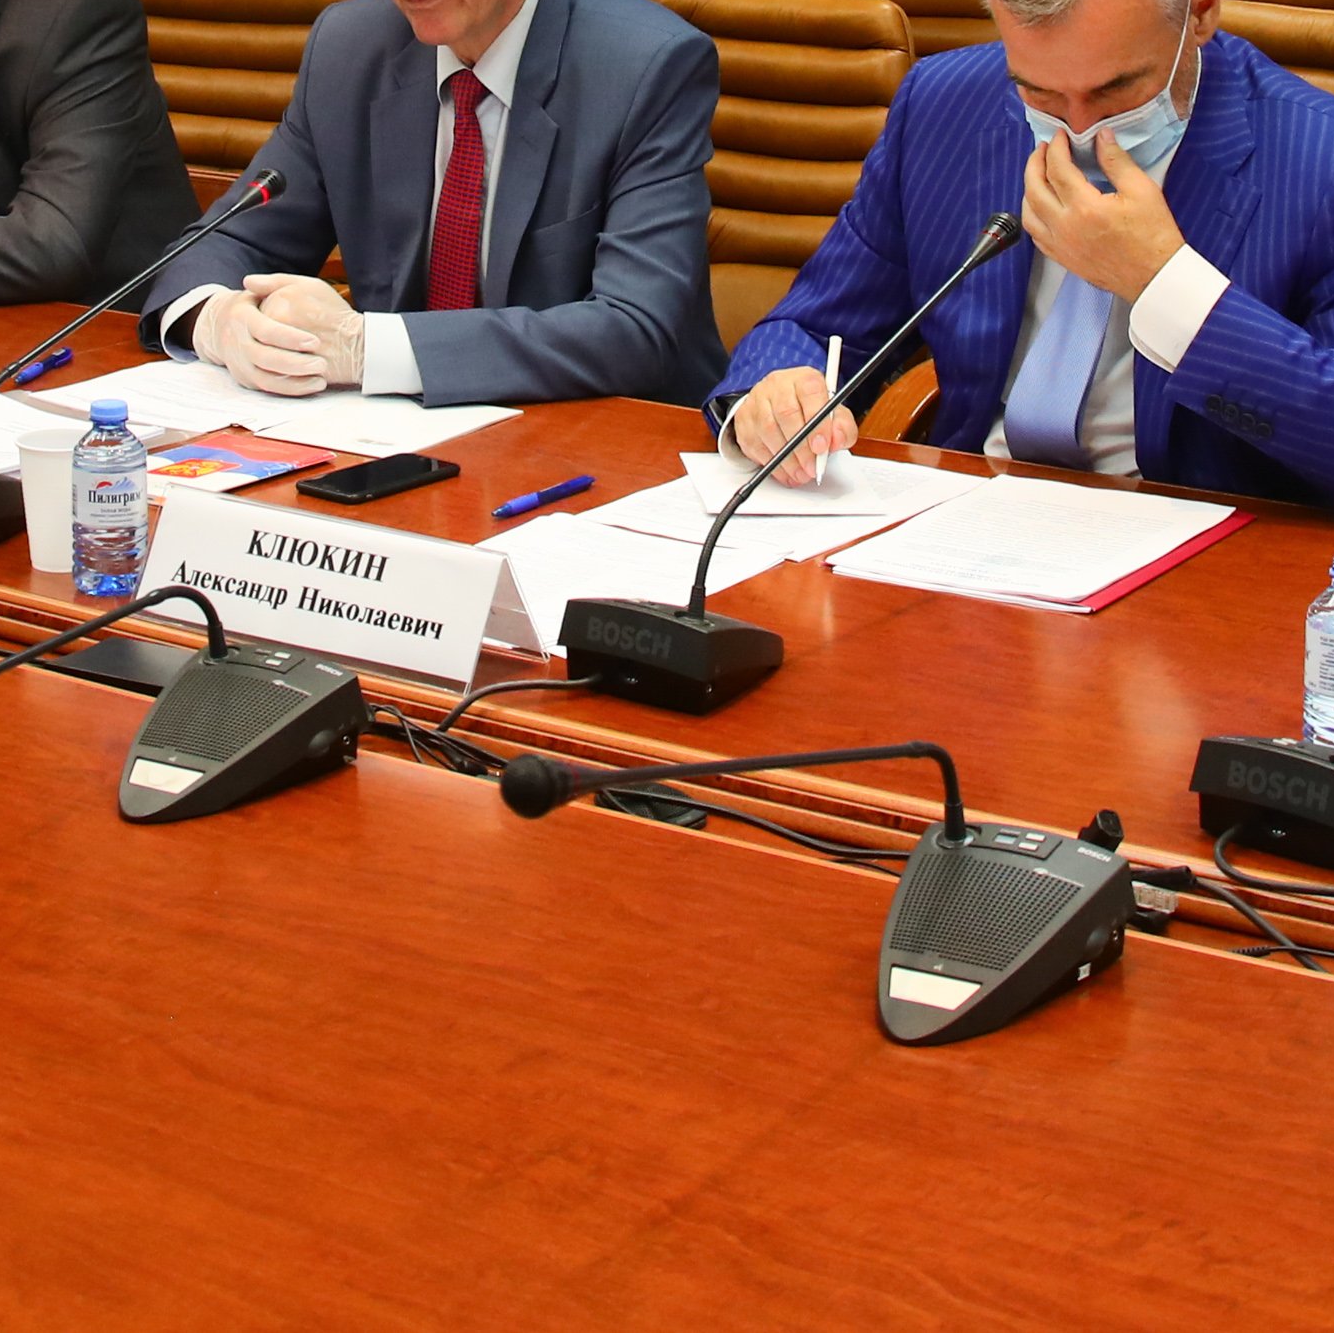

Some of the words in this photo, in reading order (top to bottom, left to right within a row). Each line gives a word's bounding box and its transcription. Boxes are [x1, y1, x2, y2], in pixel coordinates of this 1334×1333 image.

[88, 489, 141, 507] Пилигрим
[245, 529, 390, 583] КЛЮКИН
[170, 560, 289, 610] Александр
[295, 585, 445, 640] Николаевич
[586, 616, 673, 660] BOSCH
[1226, 759, 1330, 814] BOSCH
[1077, 846, 1112, 863] BOSCH
